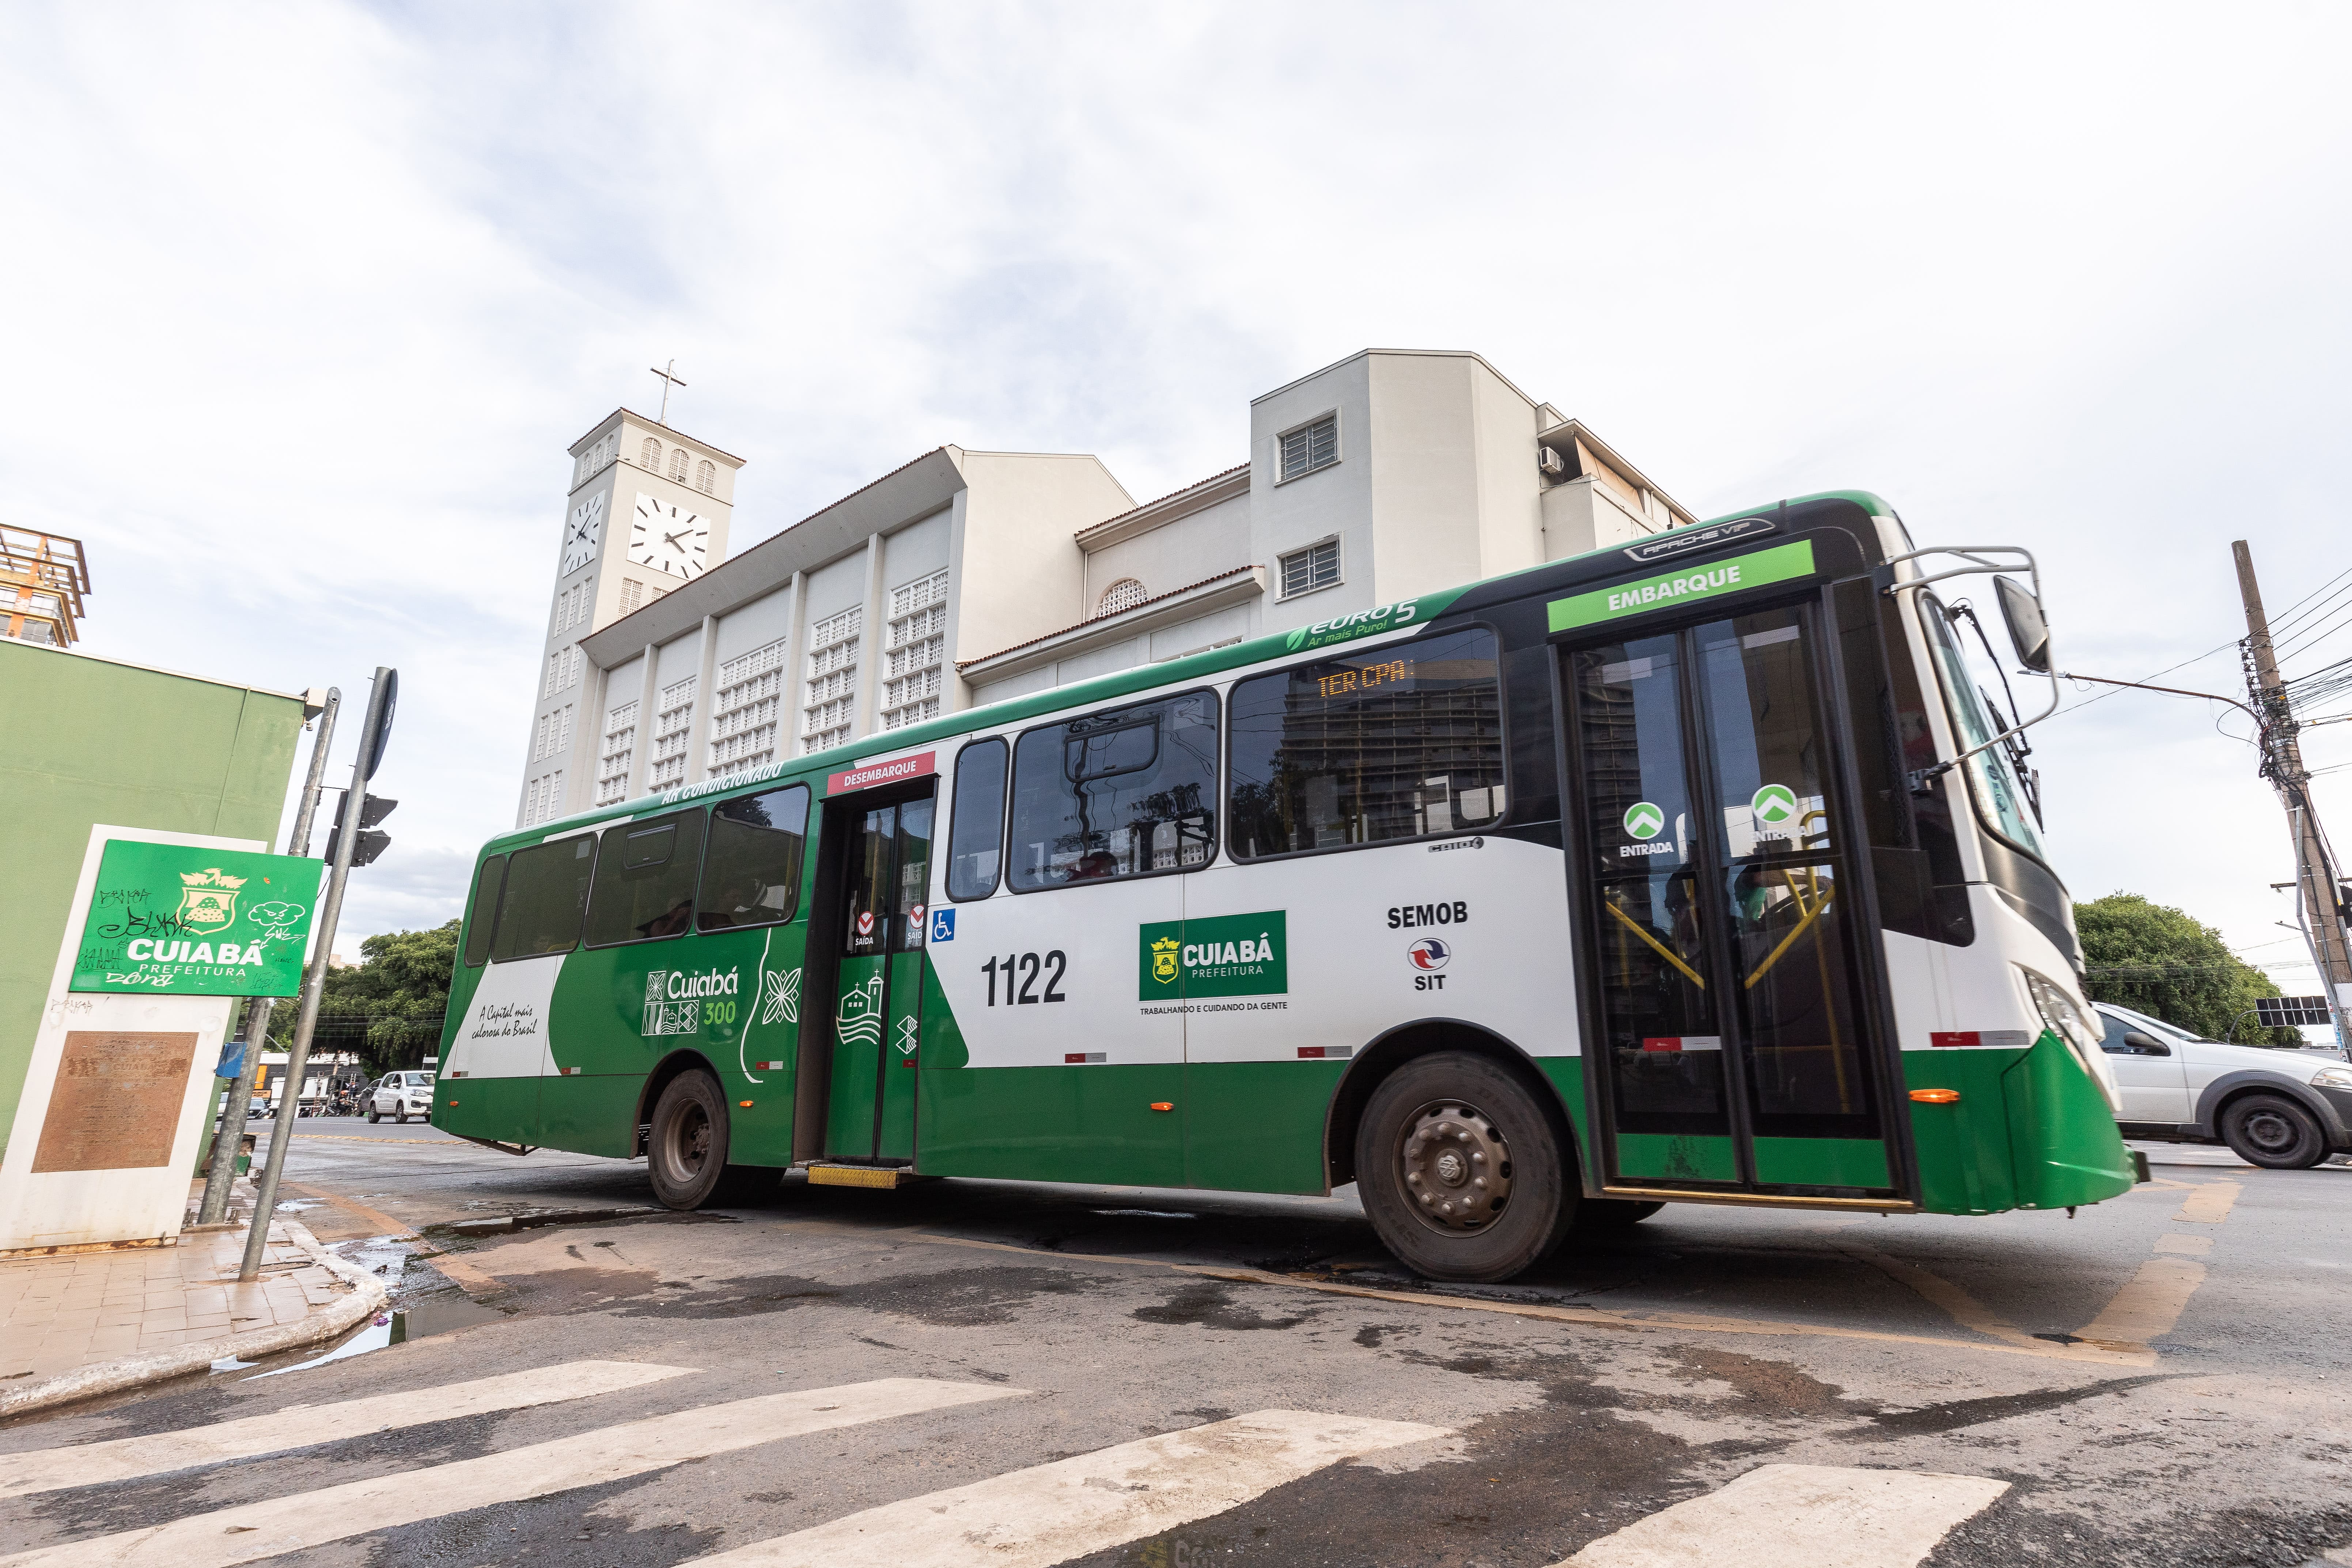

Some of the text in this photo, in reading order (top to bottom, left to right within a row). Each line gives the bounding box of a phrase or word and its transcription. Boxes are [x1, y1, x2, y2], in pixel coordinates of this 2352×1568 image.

[1643, 522, 1750, 555] APACHE VIP
[1608, 565, 1741, 611] EMBARQUE
[1311, 599, 1419, 635] EURO 5
[1307, 619, 1388, 647] Ar mais Puro!
[1318, 660, 1404, 697] TER CPA
[661, 761, 785, 804] AR CONDICIONADO
[844, 760, 917, 787] DESEMBARQUE
[1428, 841, 1471, 852] CAIO
[1749, 825, 1807, 843] ENTRADA
[1620, 842, 1674, 857] ENTRADA
[1387, 901, 1468, 929] SEMOB
[855, 936, 873, 946] SAÍDA
[908, 930, 923, 940] SAÍD
[128, 938, 263, 966] CUIABÁ
[1183, 932, 1274, 967] CUIABÁ
[139, 964, 246, 976] PREFEITURA
[668, 965, 738, 999] Cuiabá
[981, 950, 1067, 1007] 1122
[1192, 965, 1264, 978] PREFEITURA
[1414, 974, 1446, 991] SIT
[479, 1002, 533, 1024] A Capital mais
[704, 1001, 736, 1024] 300
[1140, 1005, 1194, 1015] TRABALHANDO
[1203, 1003, 1245, 1012] CUIDANDO
[1261, 1002, 1287, 1010] GENTE
[472, 1018, 537, 1039] calorosa do Brasil
